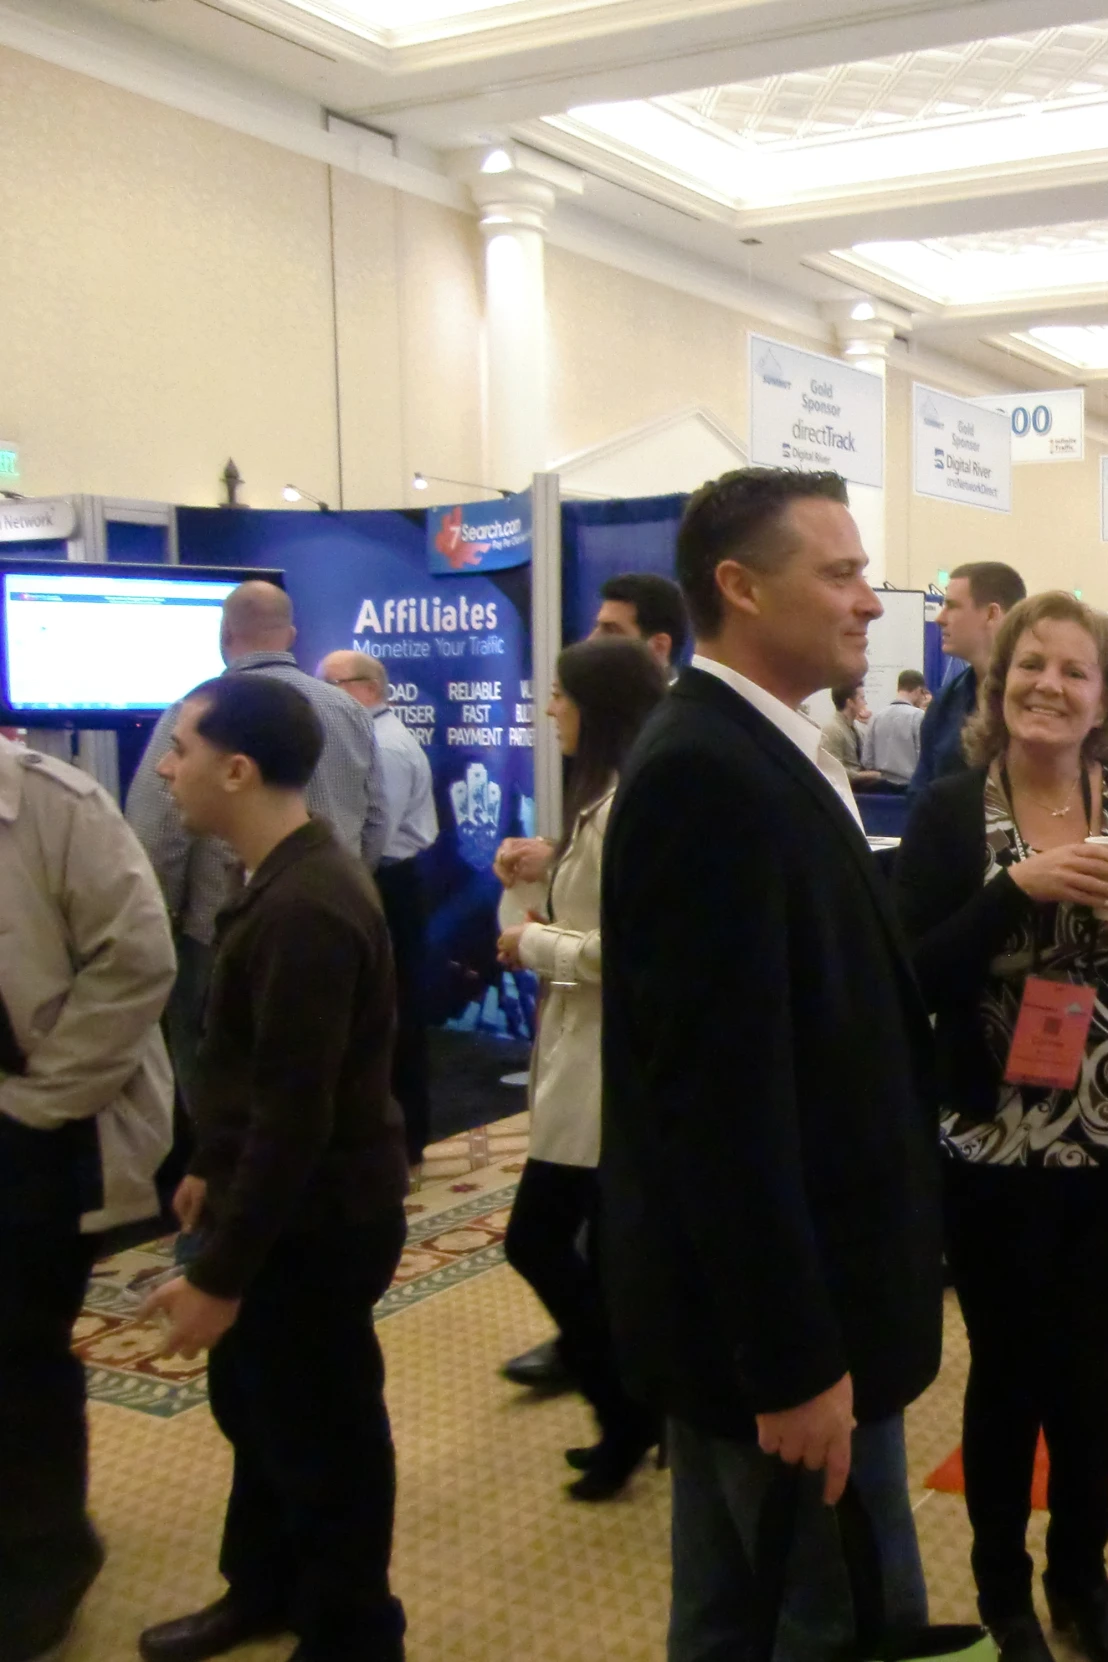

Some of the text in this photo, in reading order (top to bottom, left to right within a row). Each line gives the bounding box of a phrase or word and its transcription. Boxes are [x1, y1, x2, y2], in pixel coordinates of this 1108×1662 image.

[810, 379, 833, 399] Gold
[801, 394, 841, 416] Sponsor
[957, 420, 975, 437] Gold
[1010, 404, 1053, 438] 00
[791, 419, 855, 452] directTrack
[952, 433, 981, 452] Sponsor
[792, 447, 813, 462] Digital
[946, 454, 993, 479] Digital River
[4, 510, 54, 531] Network
[353, 595, 499, 634] Affiliates
[353, 634, 506, 658] Monetize Your Traffic
[389, 683, 419, 702] OAD
[448, 681, 503, 701] RELIABLE
[462, 704, 492, 723] FAST
[447, 727, 504, 746] PAYMENT
